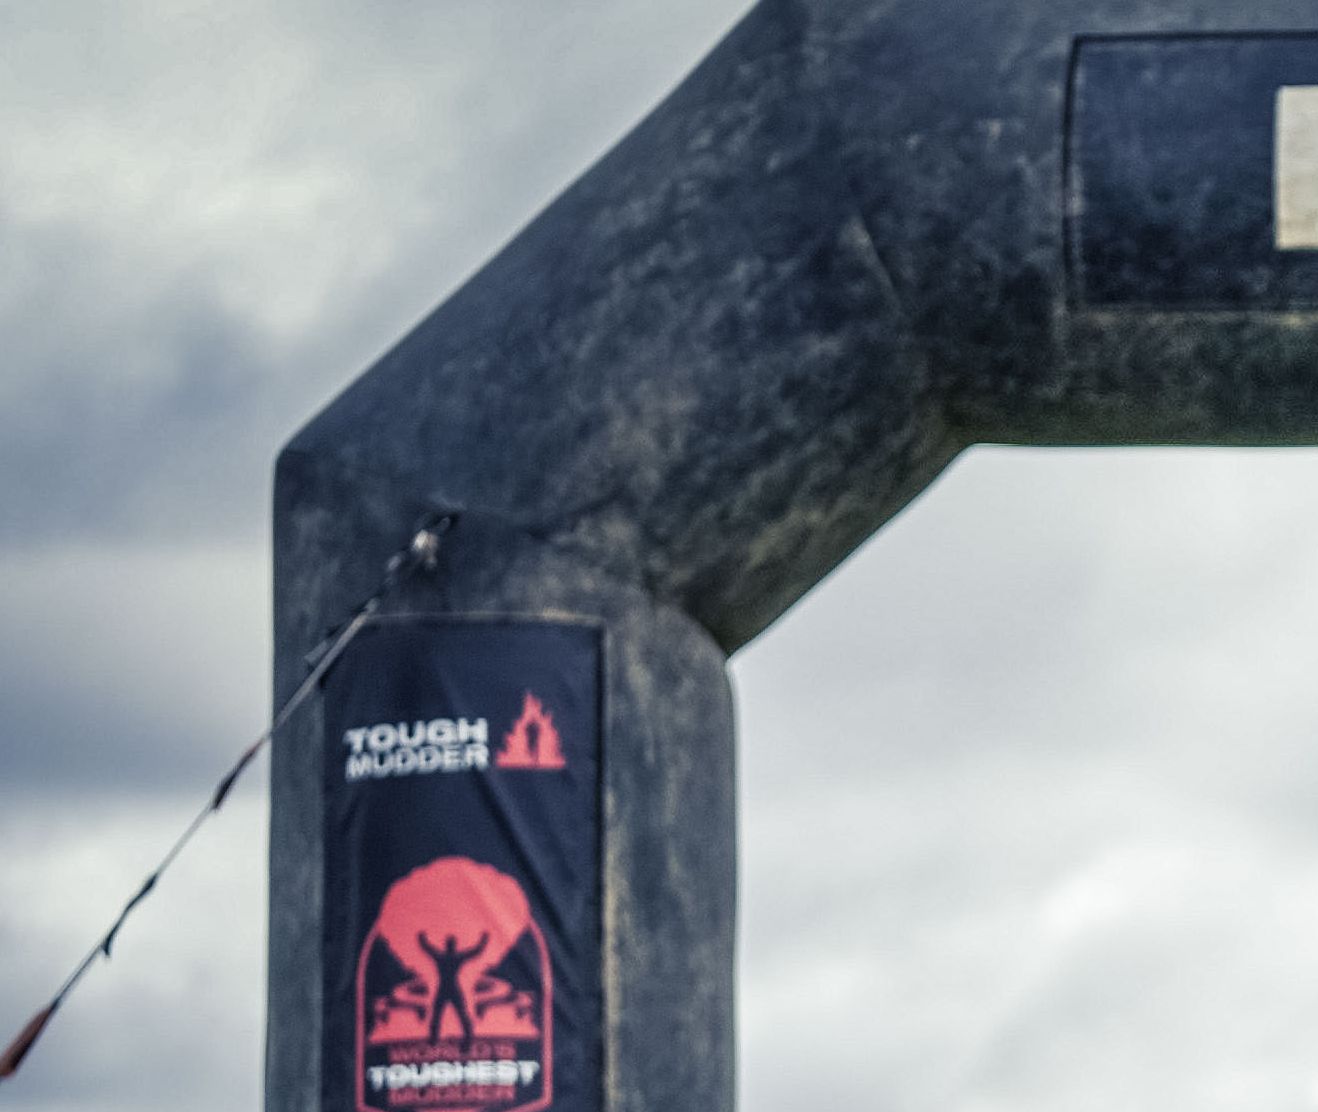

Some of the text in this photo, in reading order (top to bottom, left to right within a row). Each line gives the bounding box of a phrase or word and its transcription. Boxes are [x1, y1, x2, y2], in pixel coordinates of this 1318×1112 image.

[342, 717, 489, 754] TOUGH
[345, 744, 490, 783] MUDDER
[367, 1060, 541, 1092] TOUGHEST
